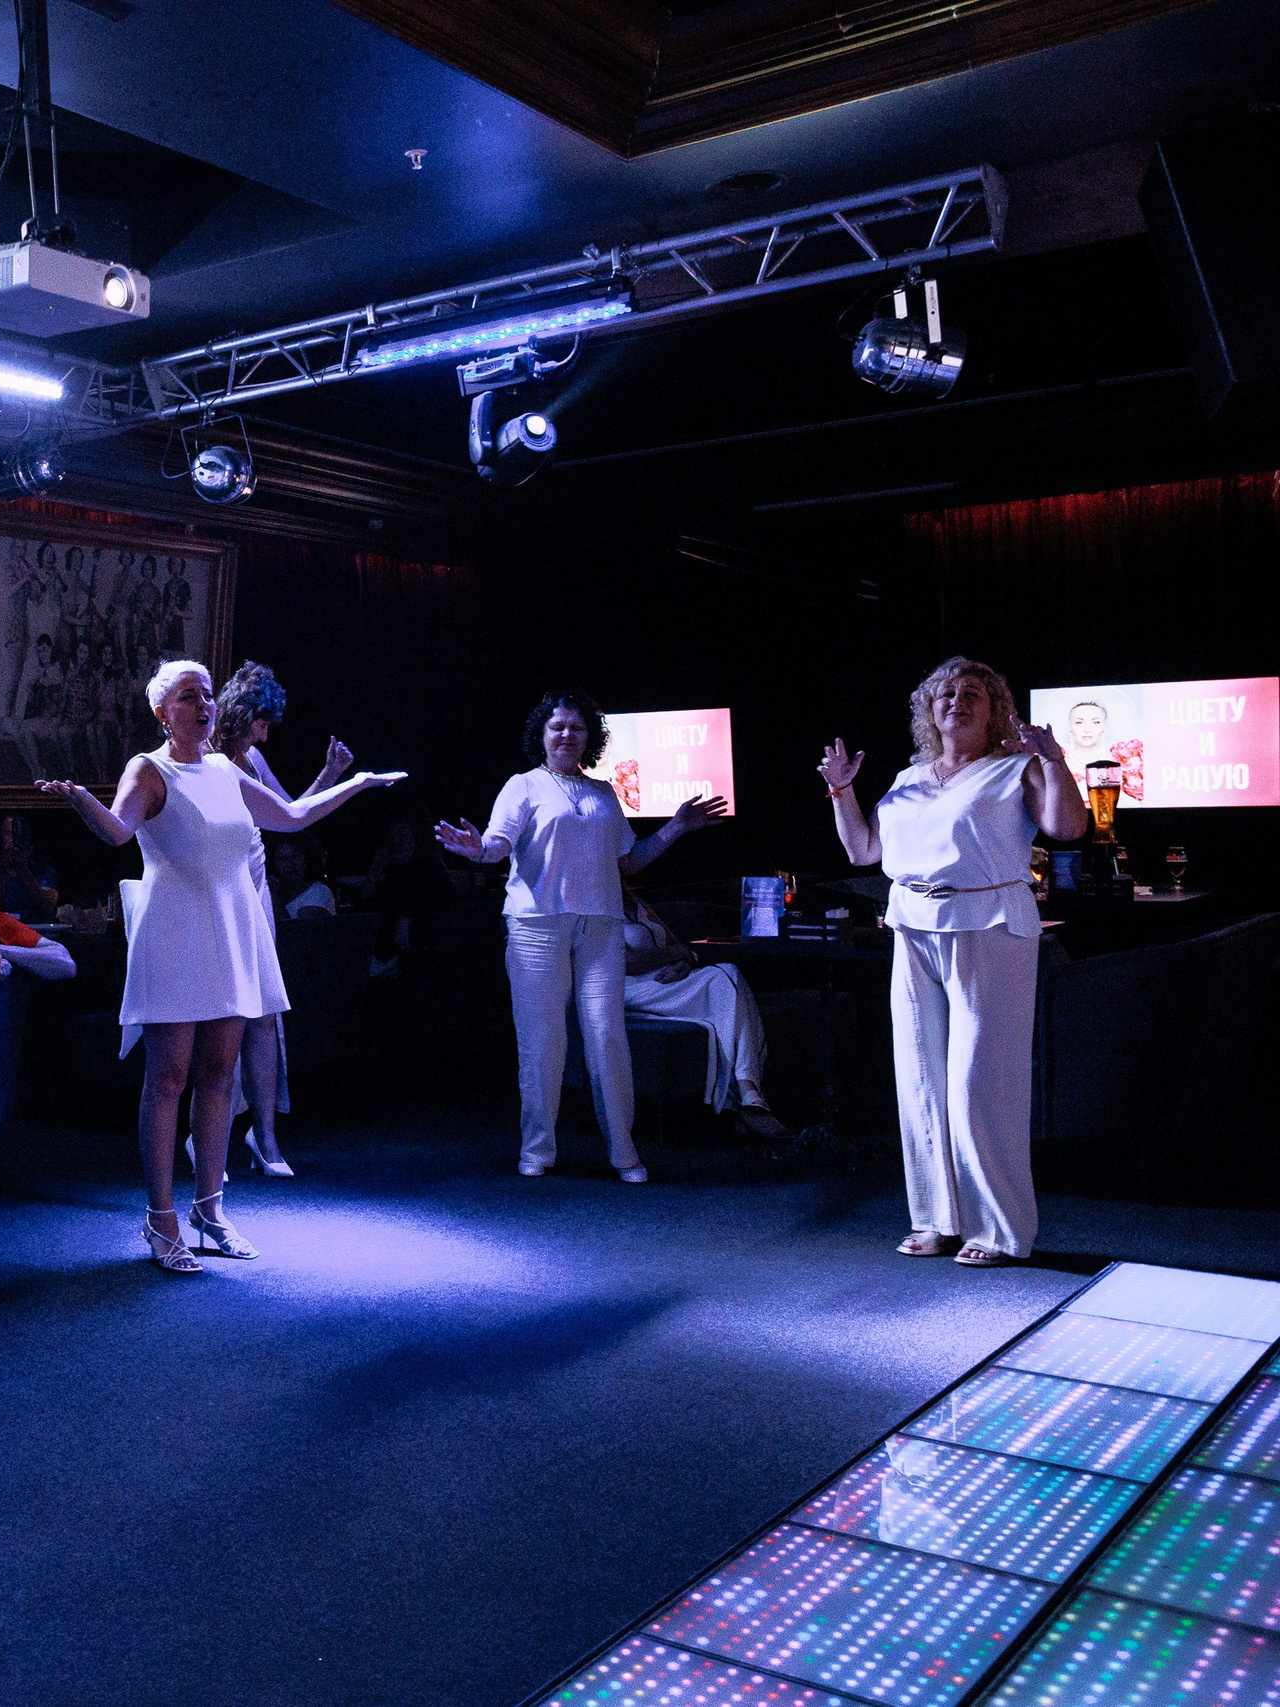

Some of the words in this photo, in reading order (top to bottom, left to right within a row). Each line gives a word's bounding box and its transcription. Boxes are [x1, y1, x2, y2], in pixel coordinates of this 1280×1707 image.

[1169, 696, 1246, 726] ЦВЕТУ
[655, 724, 708, 749] ЦВЕТУ
[1199, 731, 1216, 756] И
[677, 753, 689, 774] И
[1162, 763, 1249, 792] РАДУЮ
[652, 780, 713, 804] РАДУЮ
